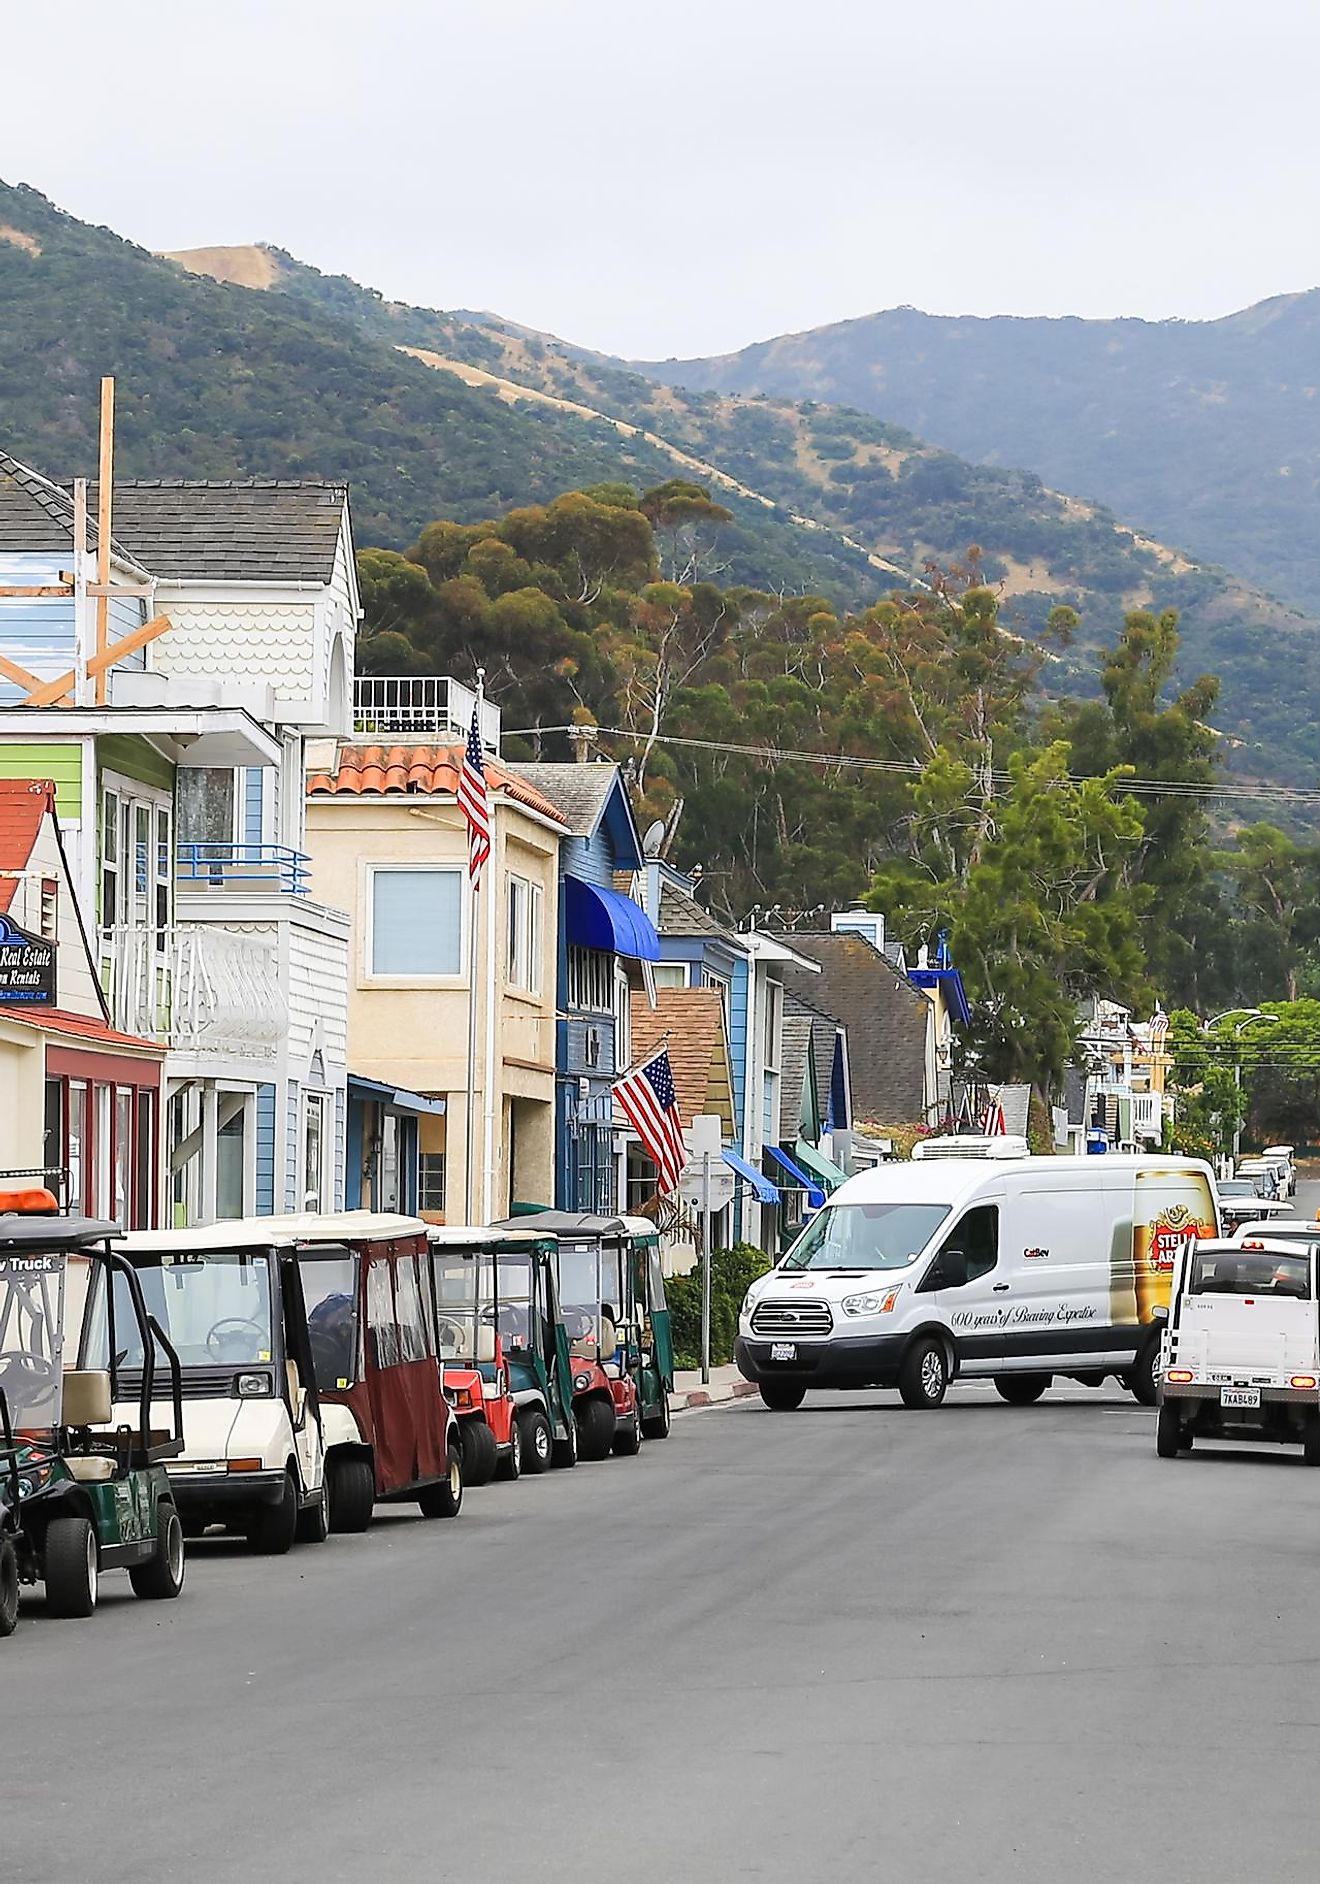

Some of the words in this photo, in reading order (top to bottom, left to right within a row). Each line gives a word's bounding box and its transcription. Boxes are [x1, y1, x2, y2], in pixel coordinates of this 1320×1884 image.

[22, 946, 51, 967] Estate
[10, 969, 41, 985] Rentals
[9, 1256, 52, 1271] Truck
[1159, 1250, 1177, 1263] AR
[951, 1311, 974, 1326] 600
